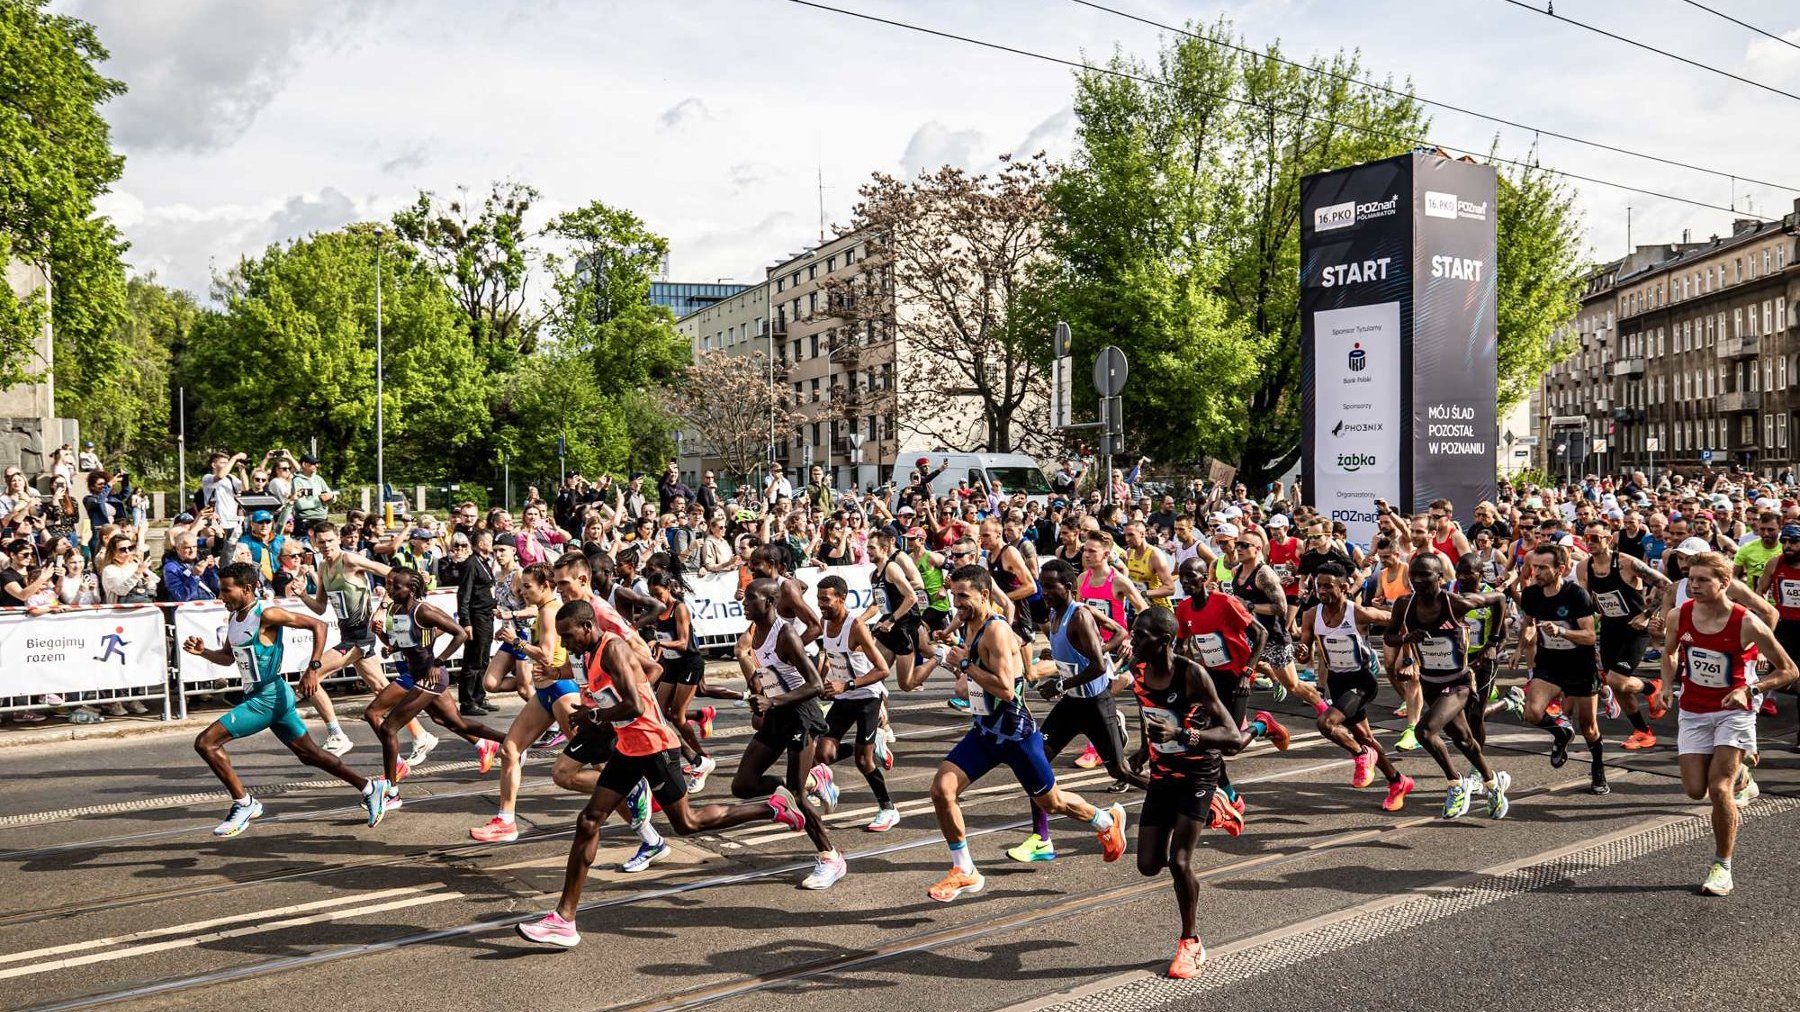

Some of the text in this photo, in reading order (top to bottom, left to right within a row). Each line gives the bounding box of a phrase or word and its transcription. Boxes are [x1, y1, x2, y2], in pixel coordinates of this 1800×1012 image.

[1321, 257, 1391, 288] START
[1431, 254, 1483, 282] START
[1429, 404, 1475, 420] MÓJ ŚLAD
[1429, 424, 1475, 437] POZOSTAŁ
[1428, 442, 1485, 454] W POZNANIU
[1337, 453, 1376, 466] żabka
[26, 636, 85, 650] Biegajmy
[26, 653, 66, 663] razem
[1693, 660, 1721, 674] 9761
